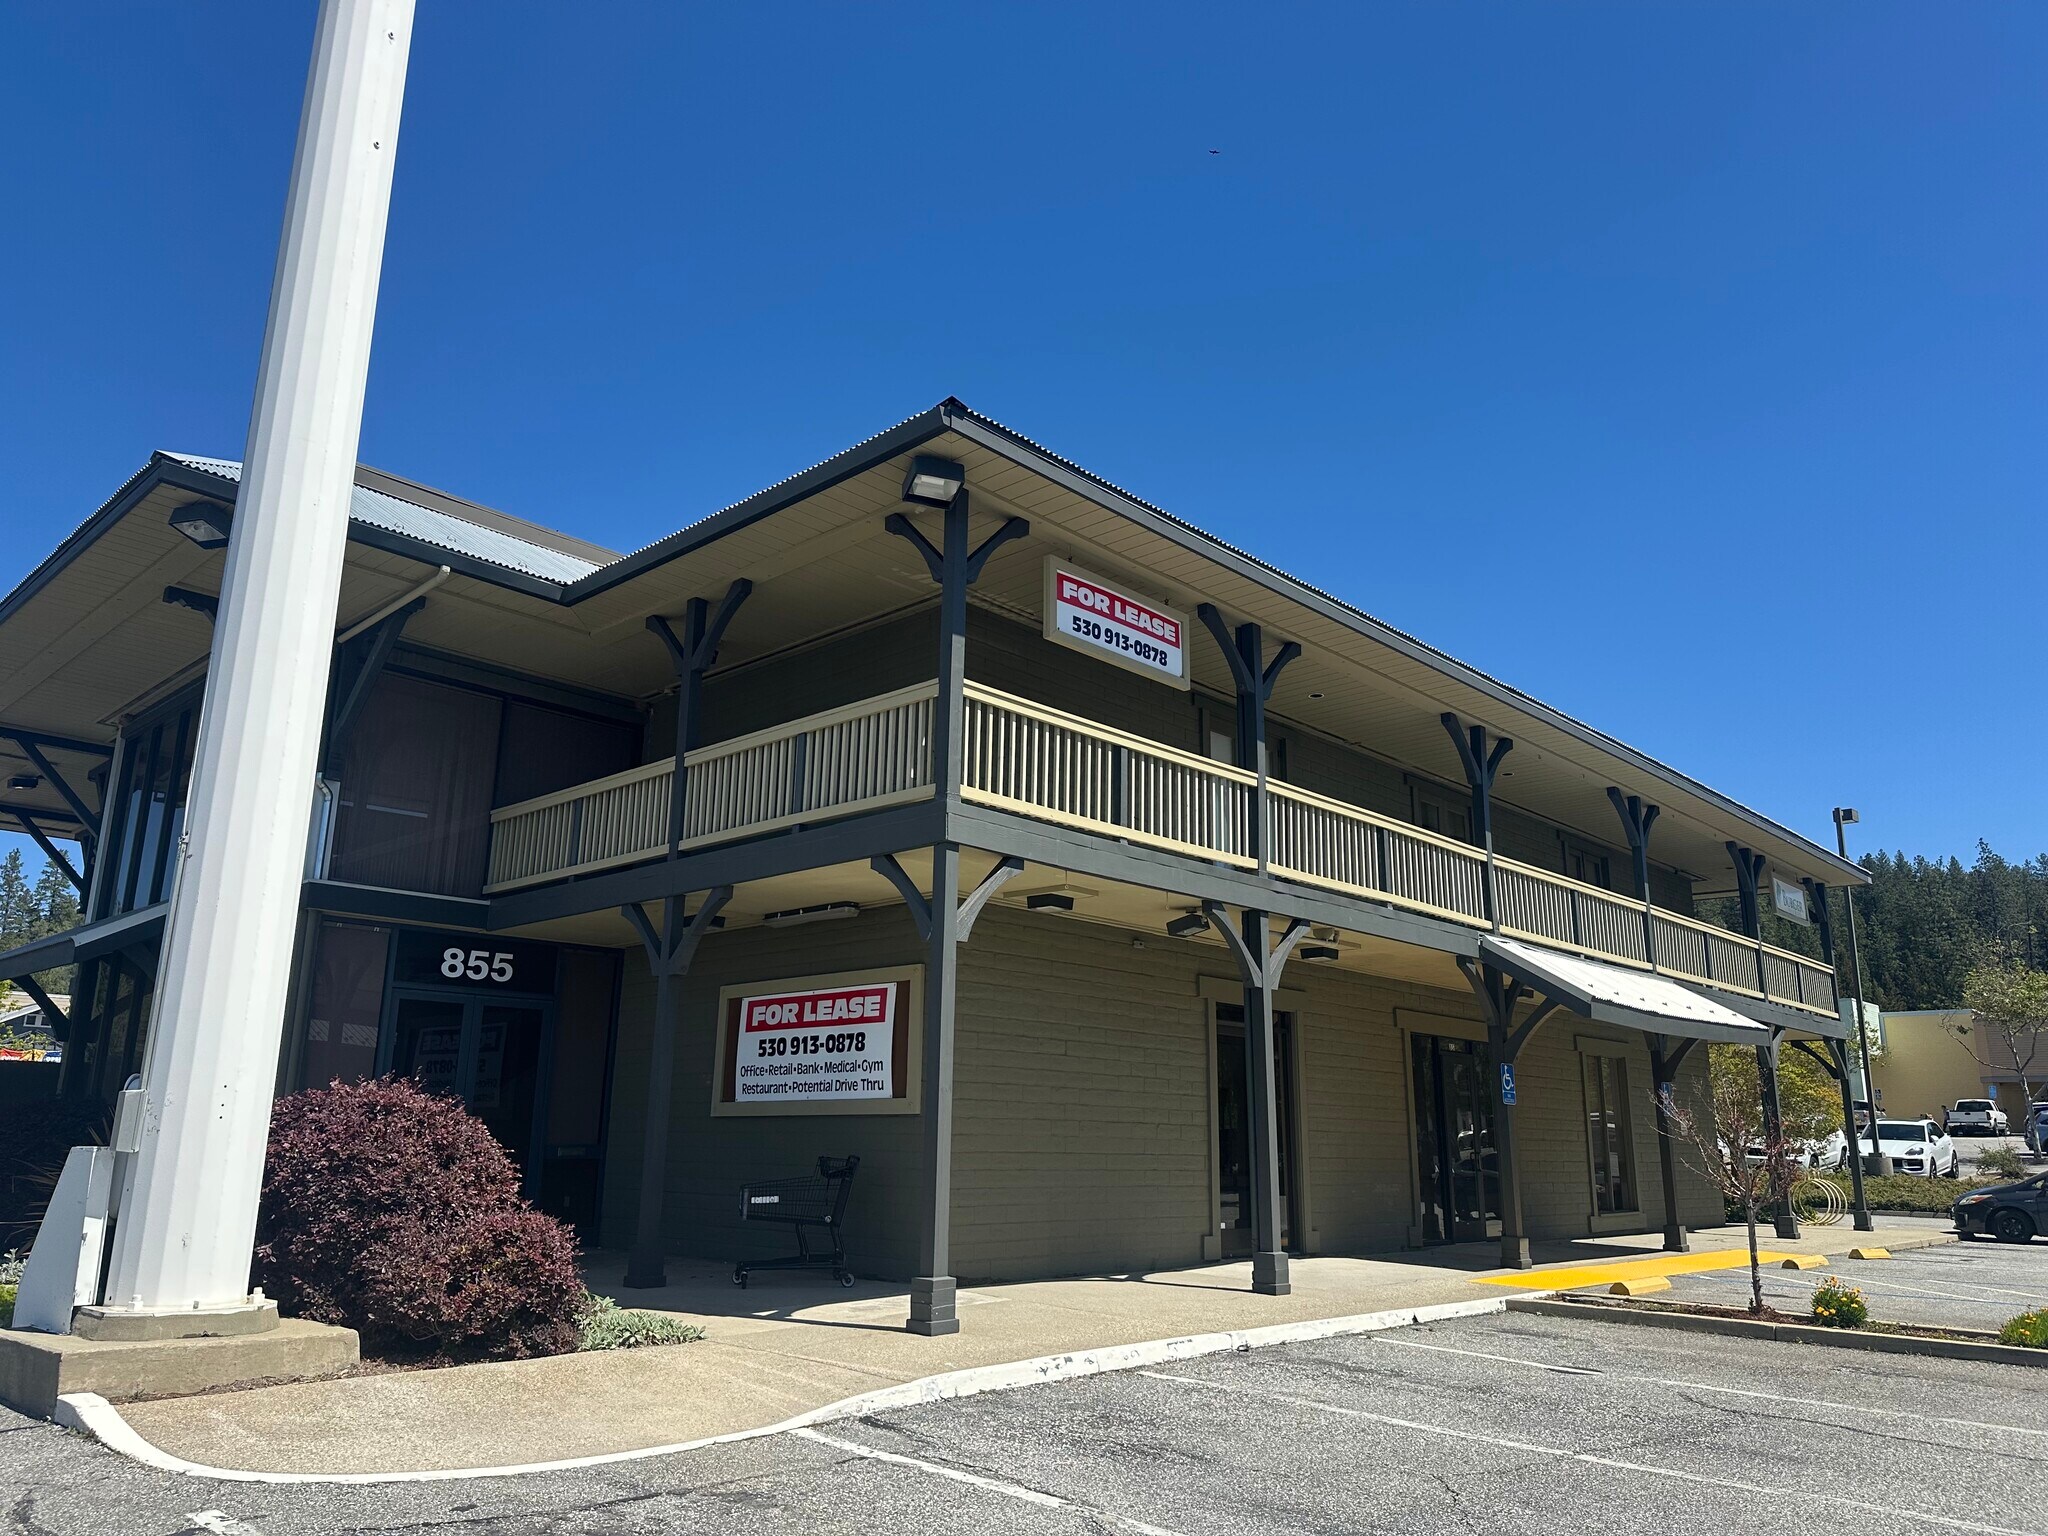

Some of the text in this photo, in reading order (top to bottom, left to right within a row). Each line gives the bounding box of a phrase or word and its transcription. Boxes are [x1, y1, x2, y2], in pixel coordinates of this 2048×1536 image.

[1062, 580, 1176, 643] FOR LEASE
[1072, 615, 1168, 667] 530 913-0878
[440, 947, 514, 982] 855
[752, 996, 881, 1026] FOR LEASE
[758, 1032, 866, 1057] 530 913-0878
[741, 1077, 884, 1095] Restaurant Potential Drive Thru
